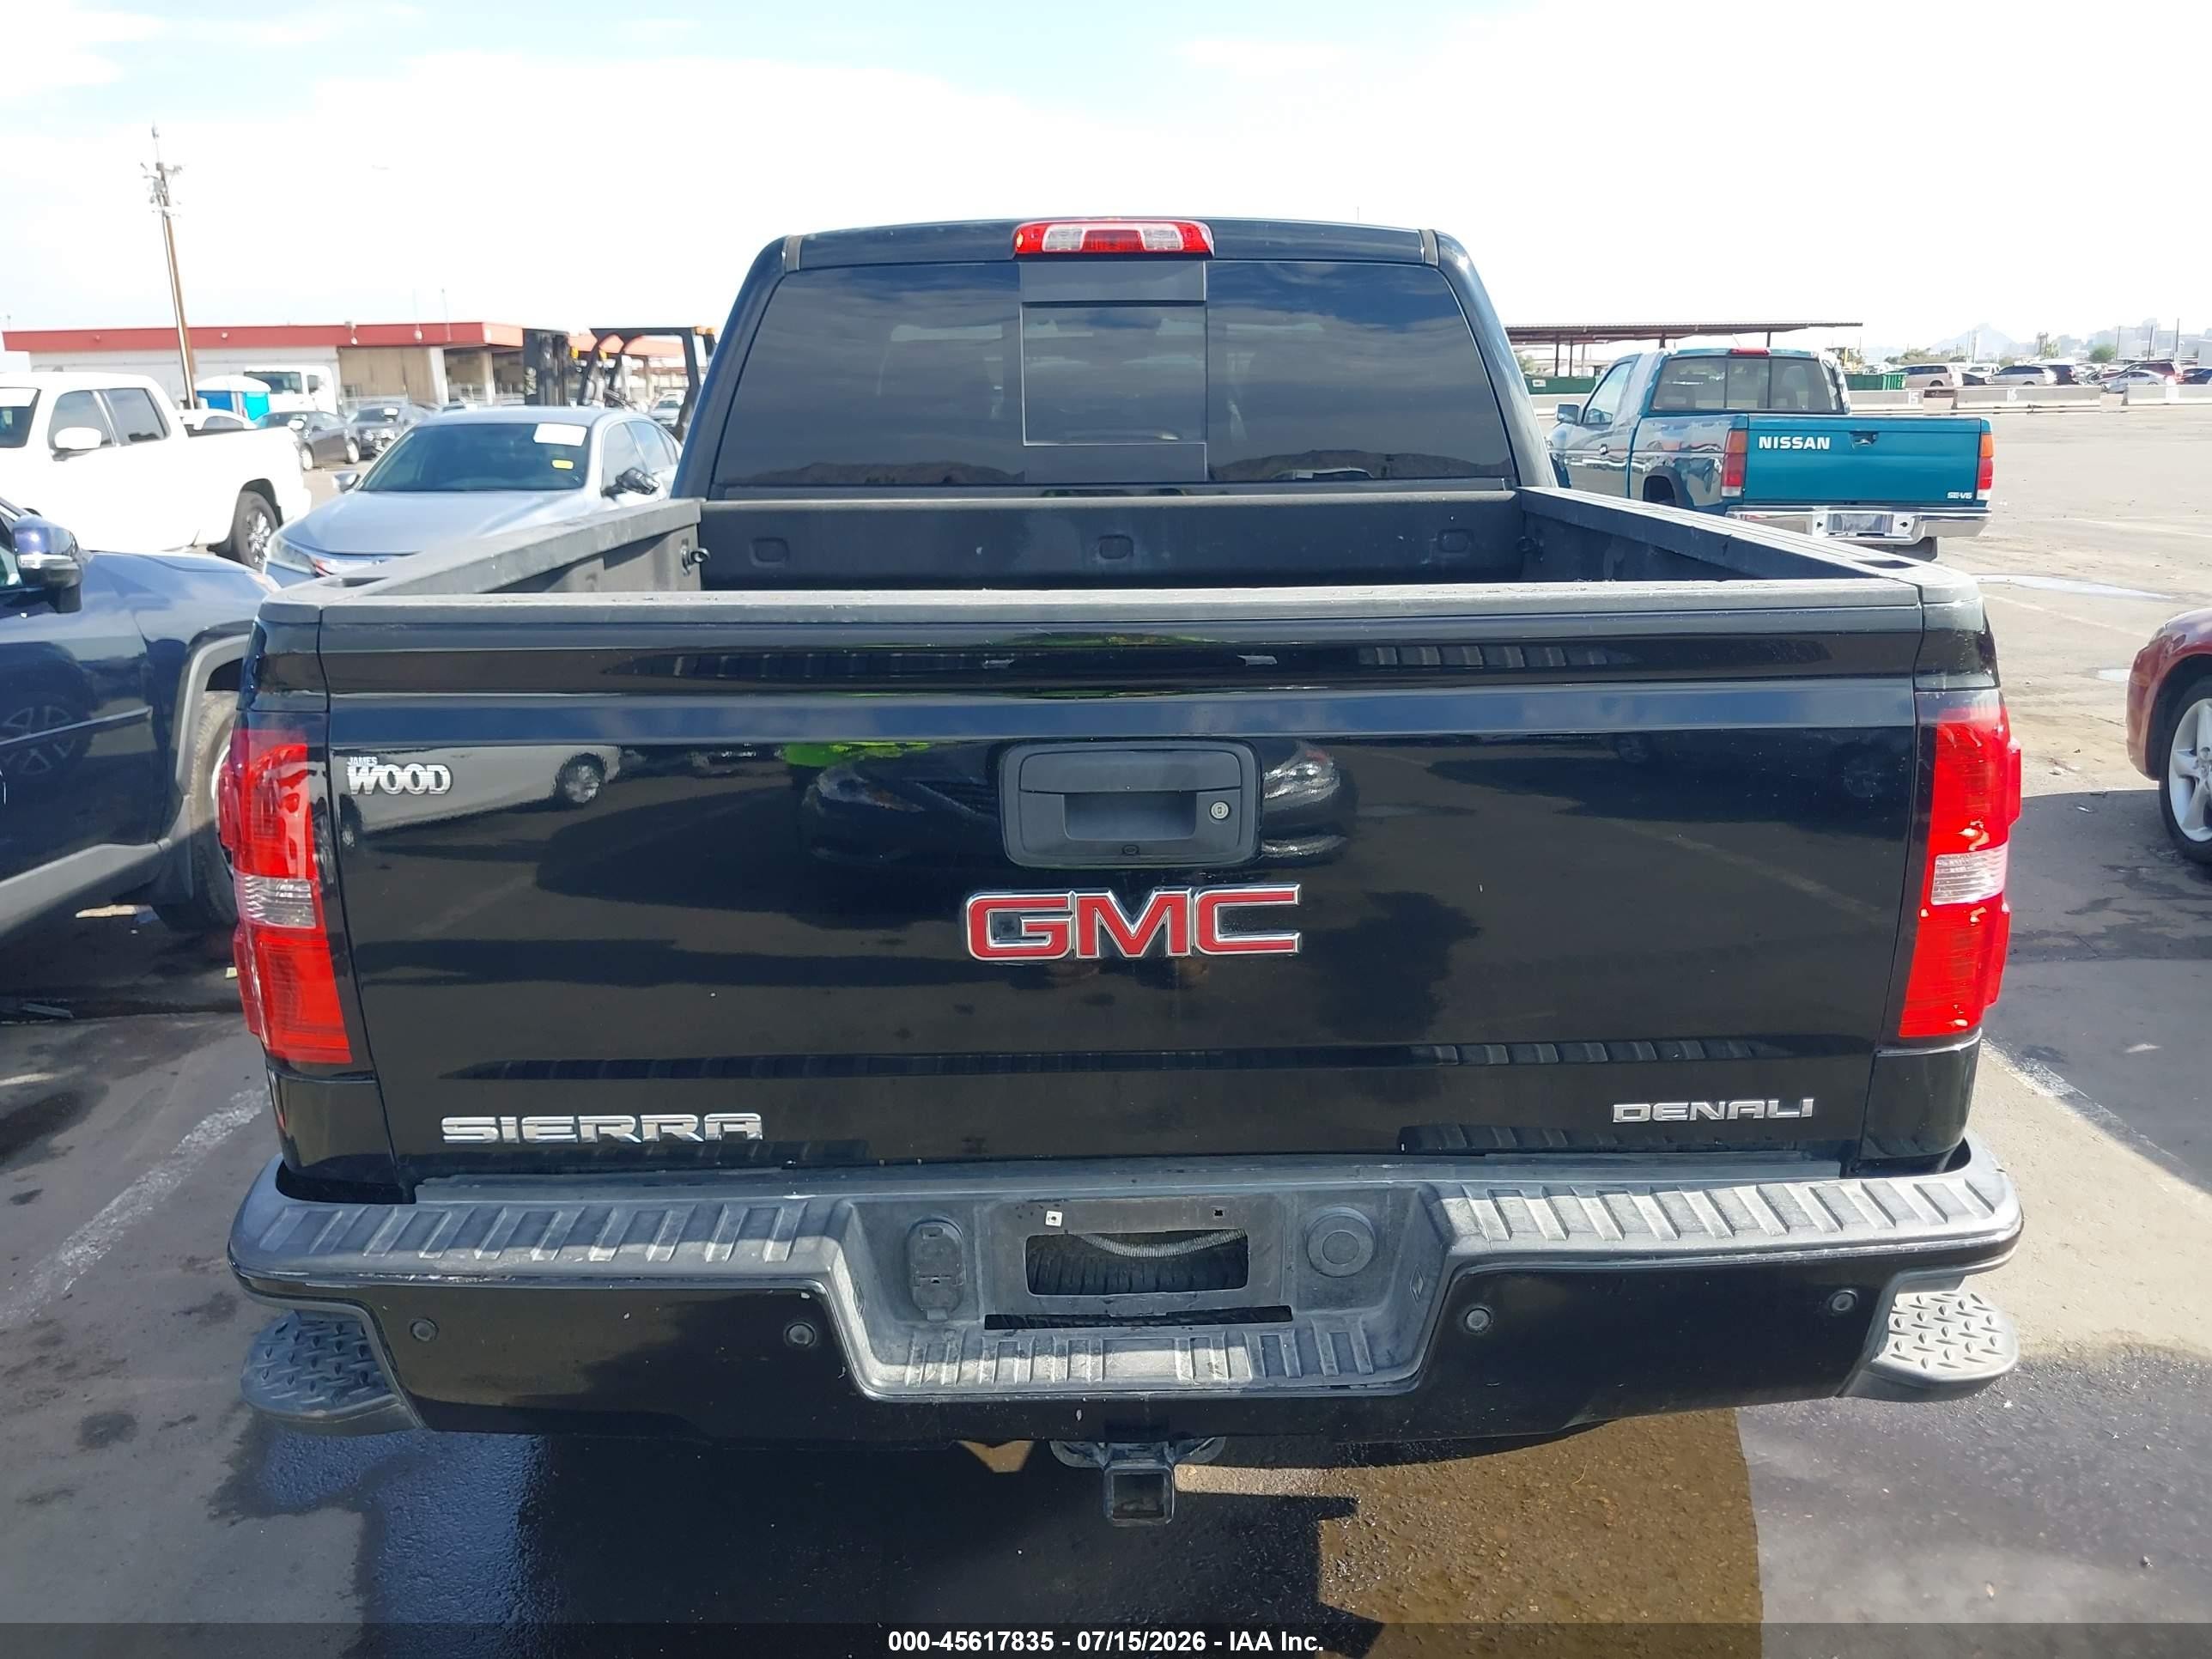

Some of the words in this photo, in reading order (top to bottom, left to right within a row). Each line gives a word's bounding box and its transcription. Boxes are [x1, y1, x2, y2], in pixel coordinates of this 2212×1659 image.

[1759, 435, 1831, 450] NISSAN
[1947, 491, 1973, 500] SE-V6
[347, 756, 378, 766] JAMES
[347, 763, 453, 795] WOOD
[966, 884, 1302, 961] GMC
[1613, 1098, 1814, 1123] DENALI
[441, 1113, 763, 1144] SIERRA
